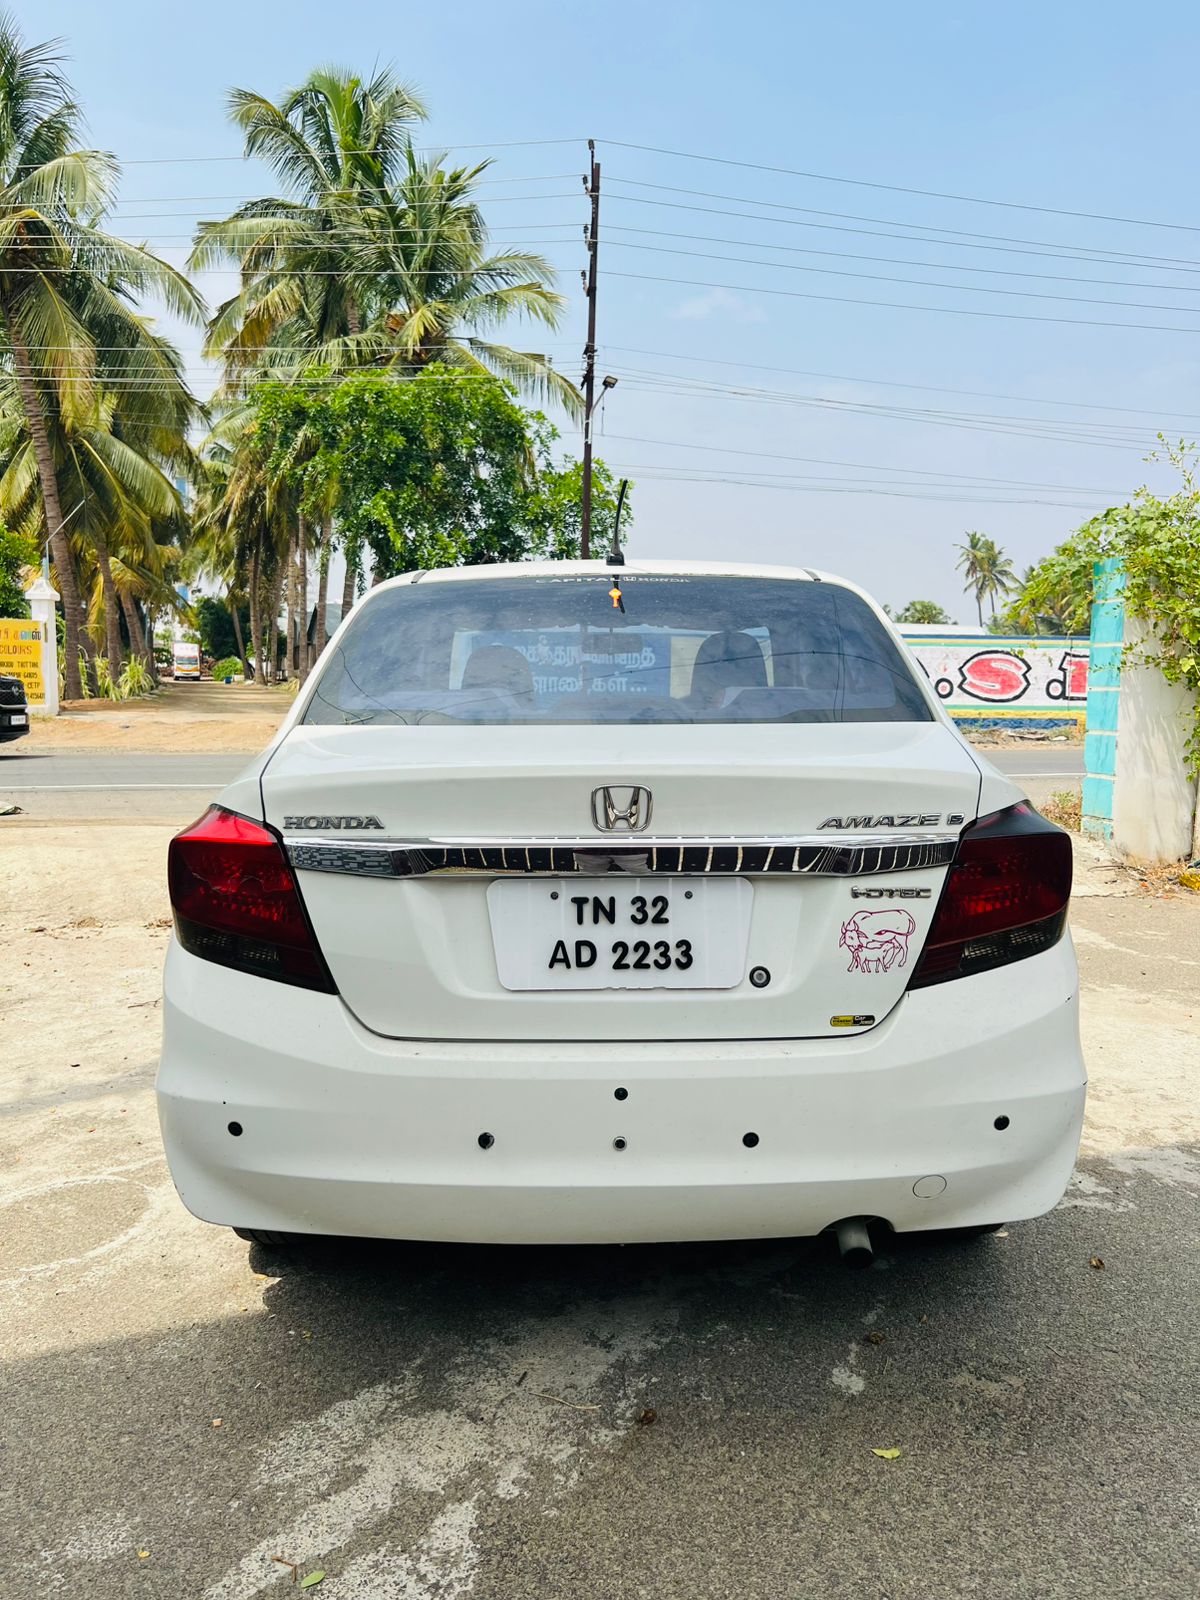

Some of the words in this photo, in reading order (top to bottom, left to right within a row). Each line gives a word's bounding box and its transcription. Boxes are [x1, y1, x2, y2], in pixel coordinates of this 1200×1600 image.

[283, 815, 385, 830] HONDA
[816, 813, 941, 830] AMAZE
[570, 896, 616, 925] TN
[630, 895, 670, 925] 32
[548, 939, 598, 970] AD
[611, 939, 694, 970] 2233
